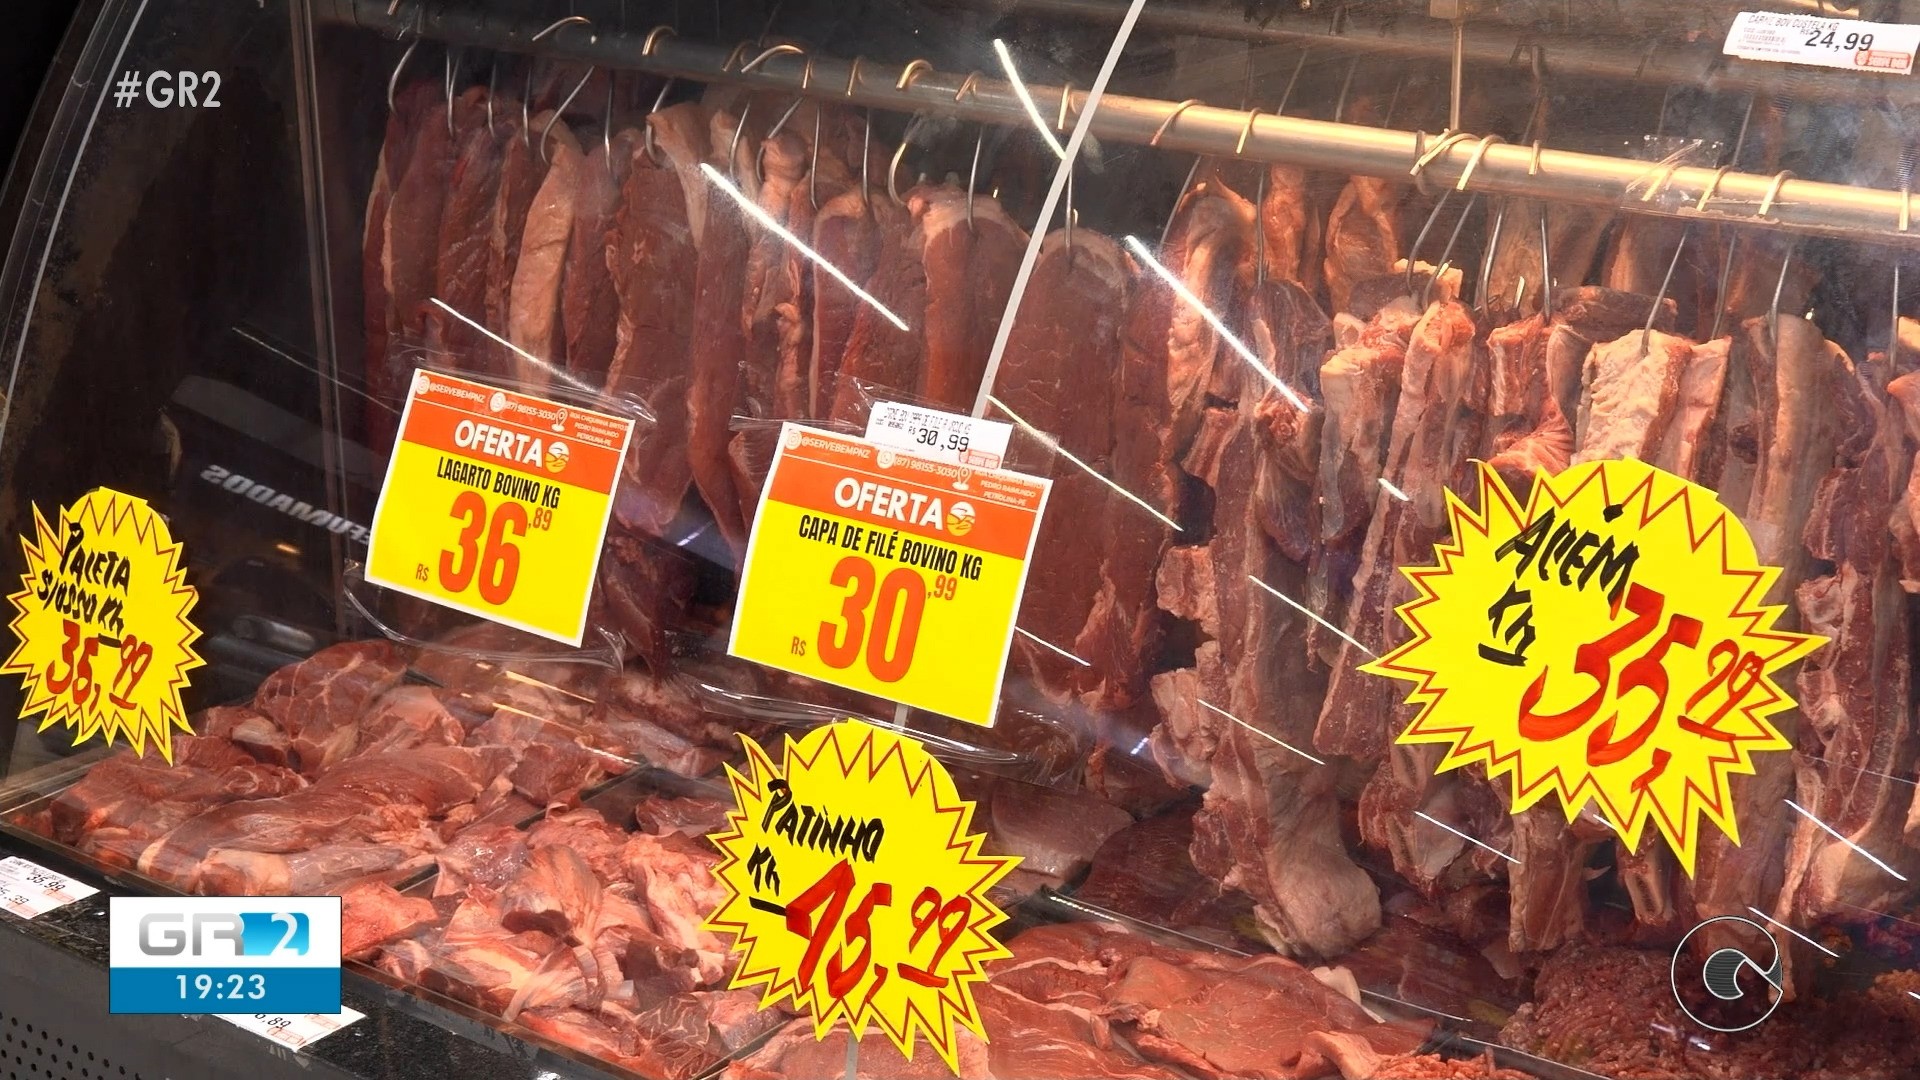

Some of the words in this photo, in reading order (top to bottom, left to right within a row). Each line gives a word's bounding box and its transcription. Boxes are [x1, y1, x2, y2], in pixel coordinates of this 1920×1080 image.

[1805, 30, 1874, 52] 24,99
[454, 419, 543, 468] OFERTA
[916, 428, 970, 453] 30,99
[437, 456, 491, 490] LAGARTO
[493, 472, 539, 504] BOVINO
[542, 485, 561, 509] KG
[834, 477, 943, 530] OFERTA
[799, 514, 837, 546] CAPA
[841, 525, 860, 551] DE
[866, 531, 898, 560] FILÉ
[899, 538, 957, 574] BOVINO
[960, 555, 983, 581] KG
